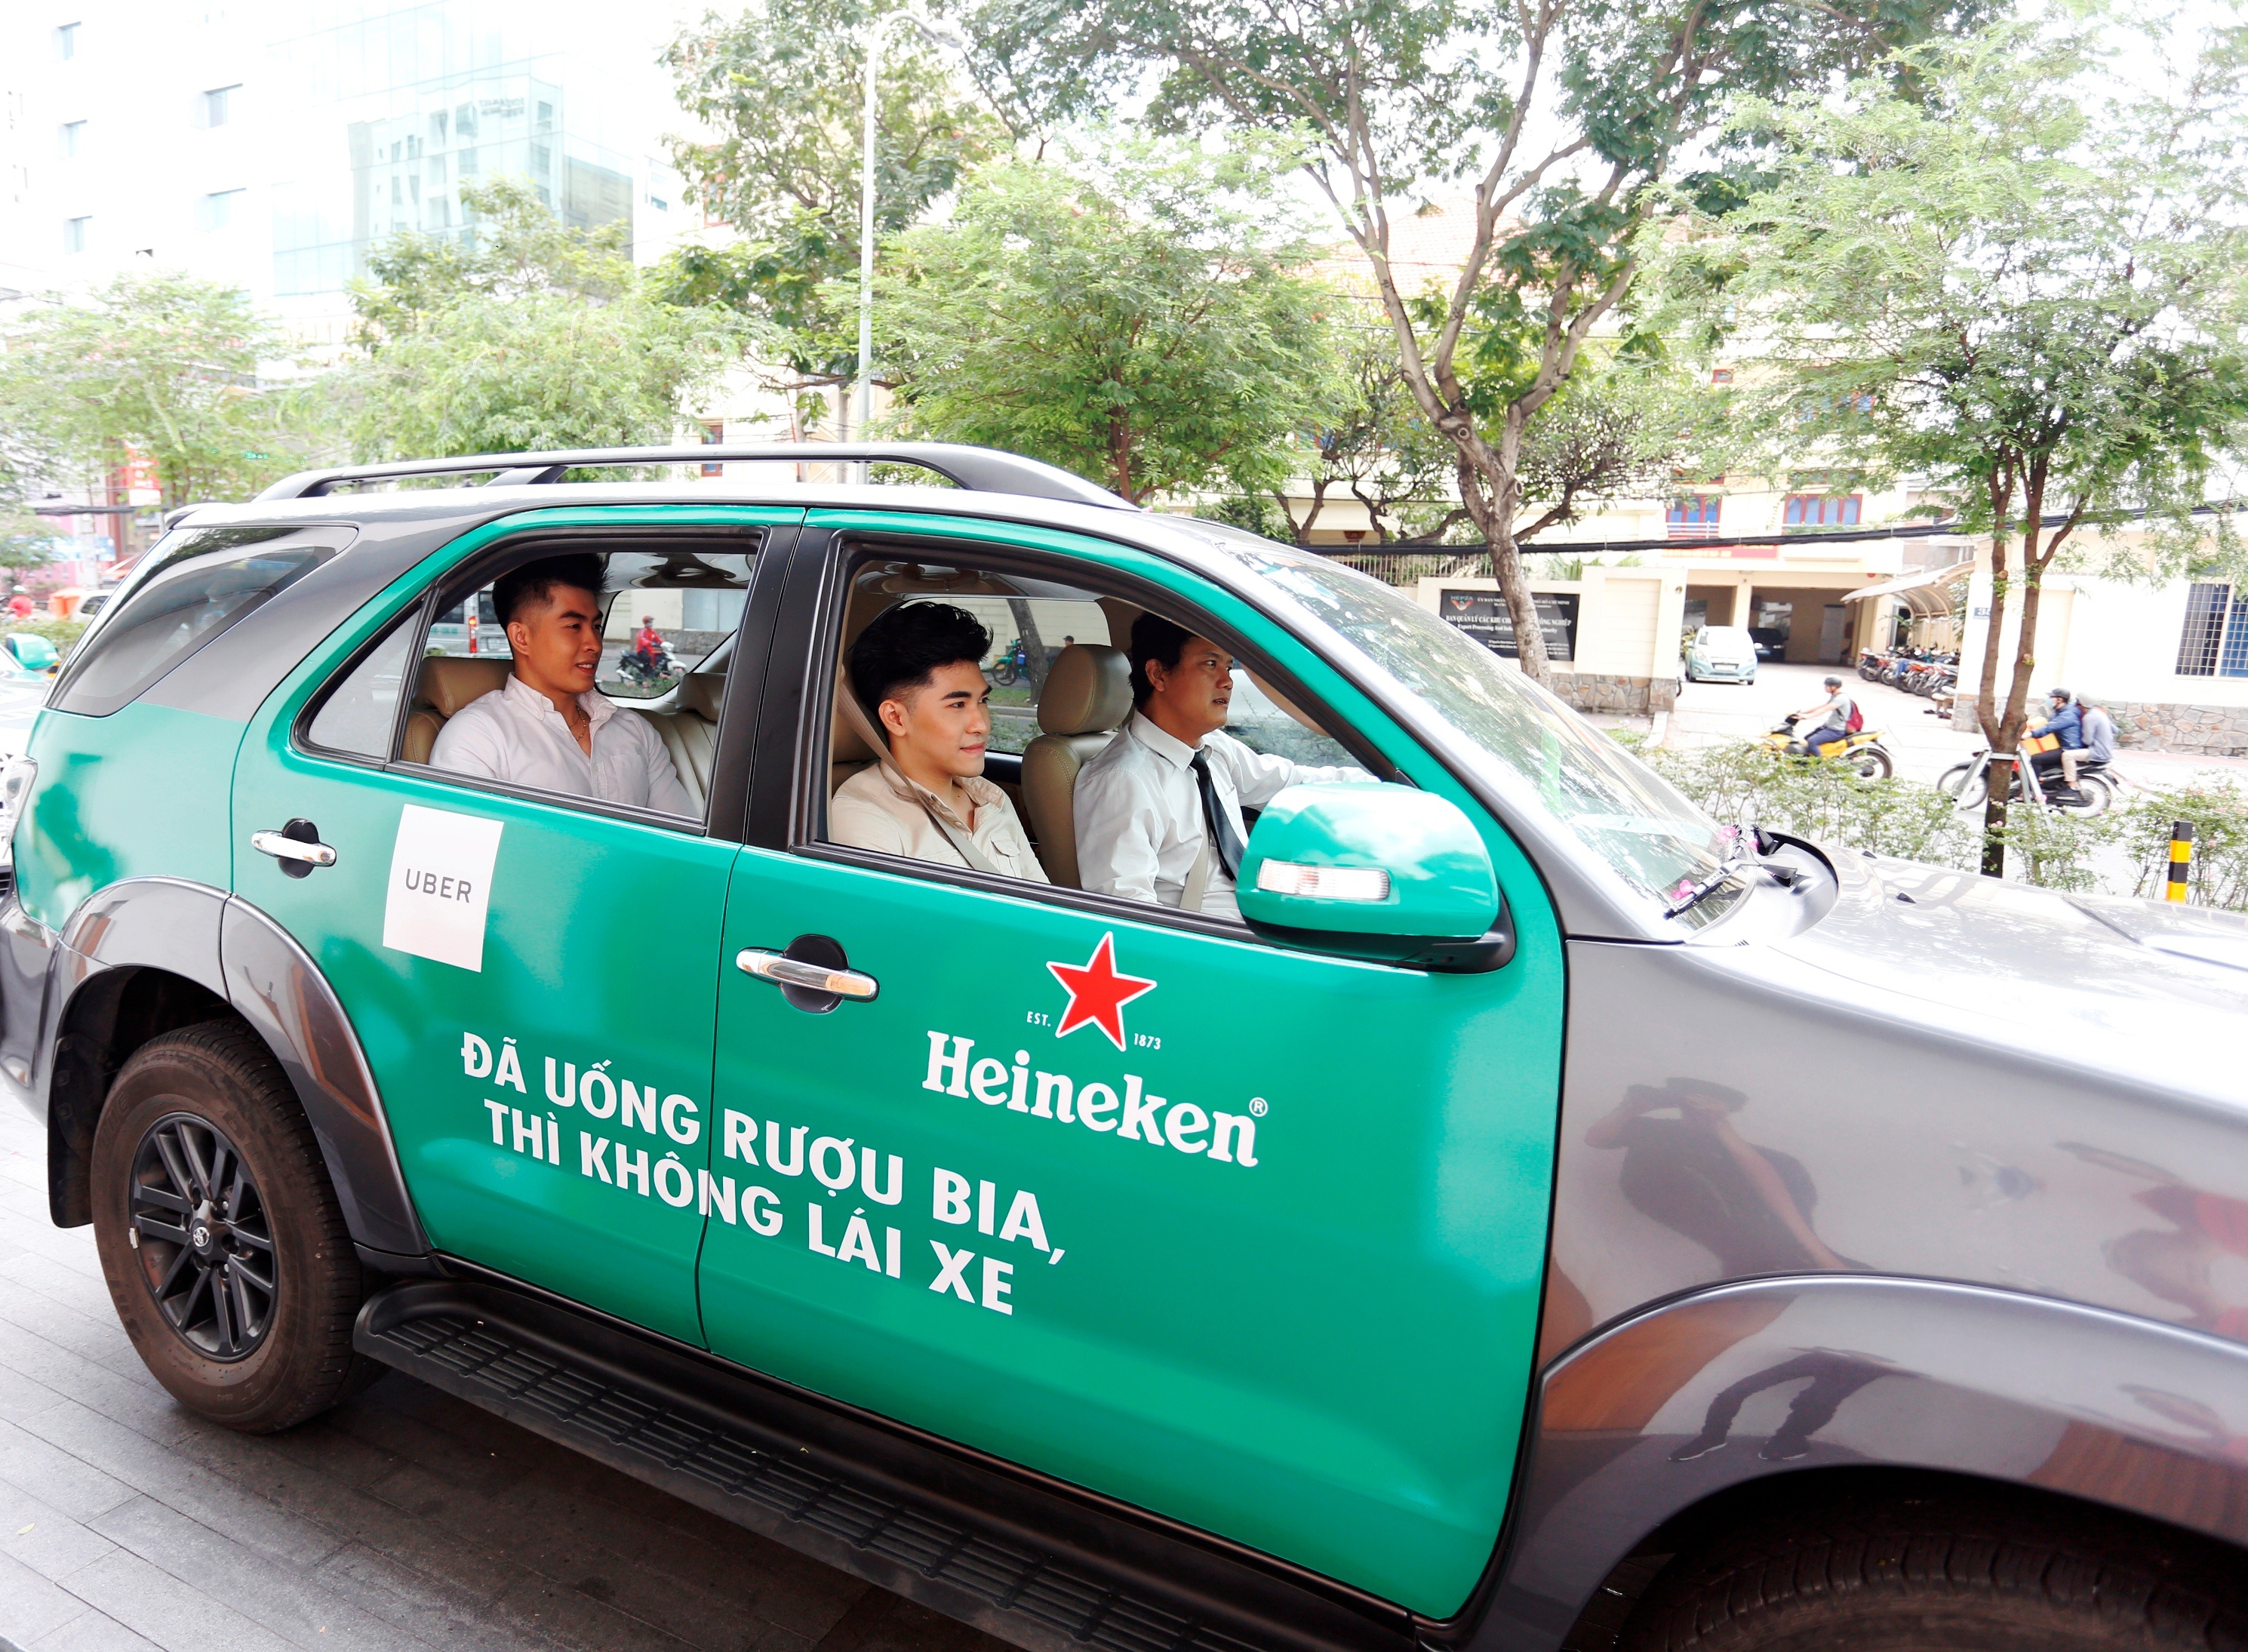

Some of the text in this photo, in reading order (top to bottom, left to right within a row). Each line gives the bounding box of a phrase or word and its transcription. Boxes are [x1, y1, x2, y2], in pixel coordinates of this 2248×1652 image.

[405, 868, 472, 903] UBER
[1026, 1011, 1051, 1027] EST.
[1133, 1033, 1161, 1050] 1873
[460, 1032, 1066, 1265] ĐÃ UỐNG RƯỢU BIA,
[484, 1098, 1013, 1315] THÌ KHÔNG LÁI XE
